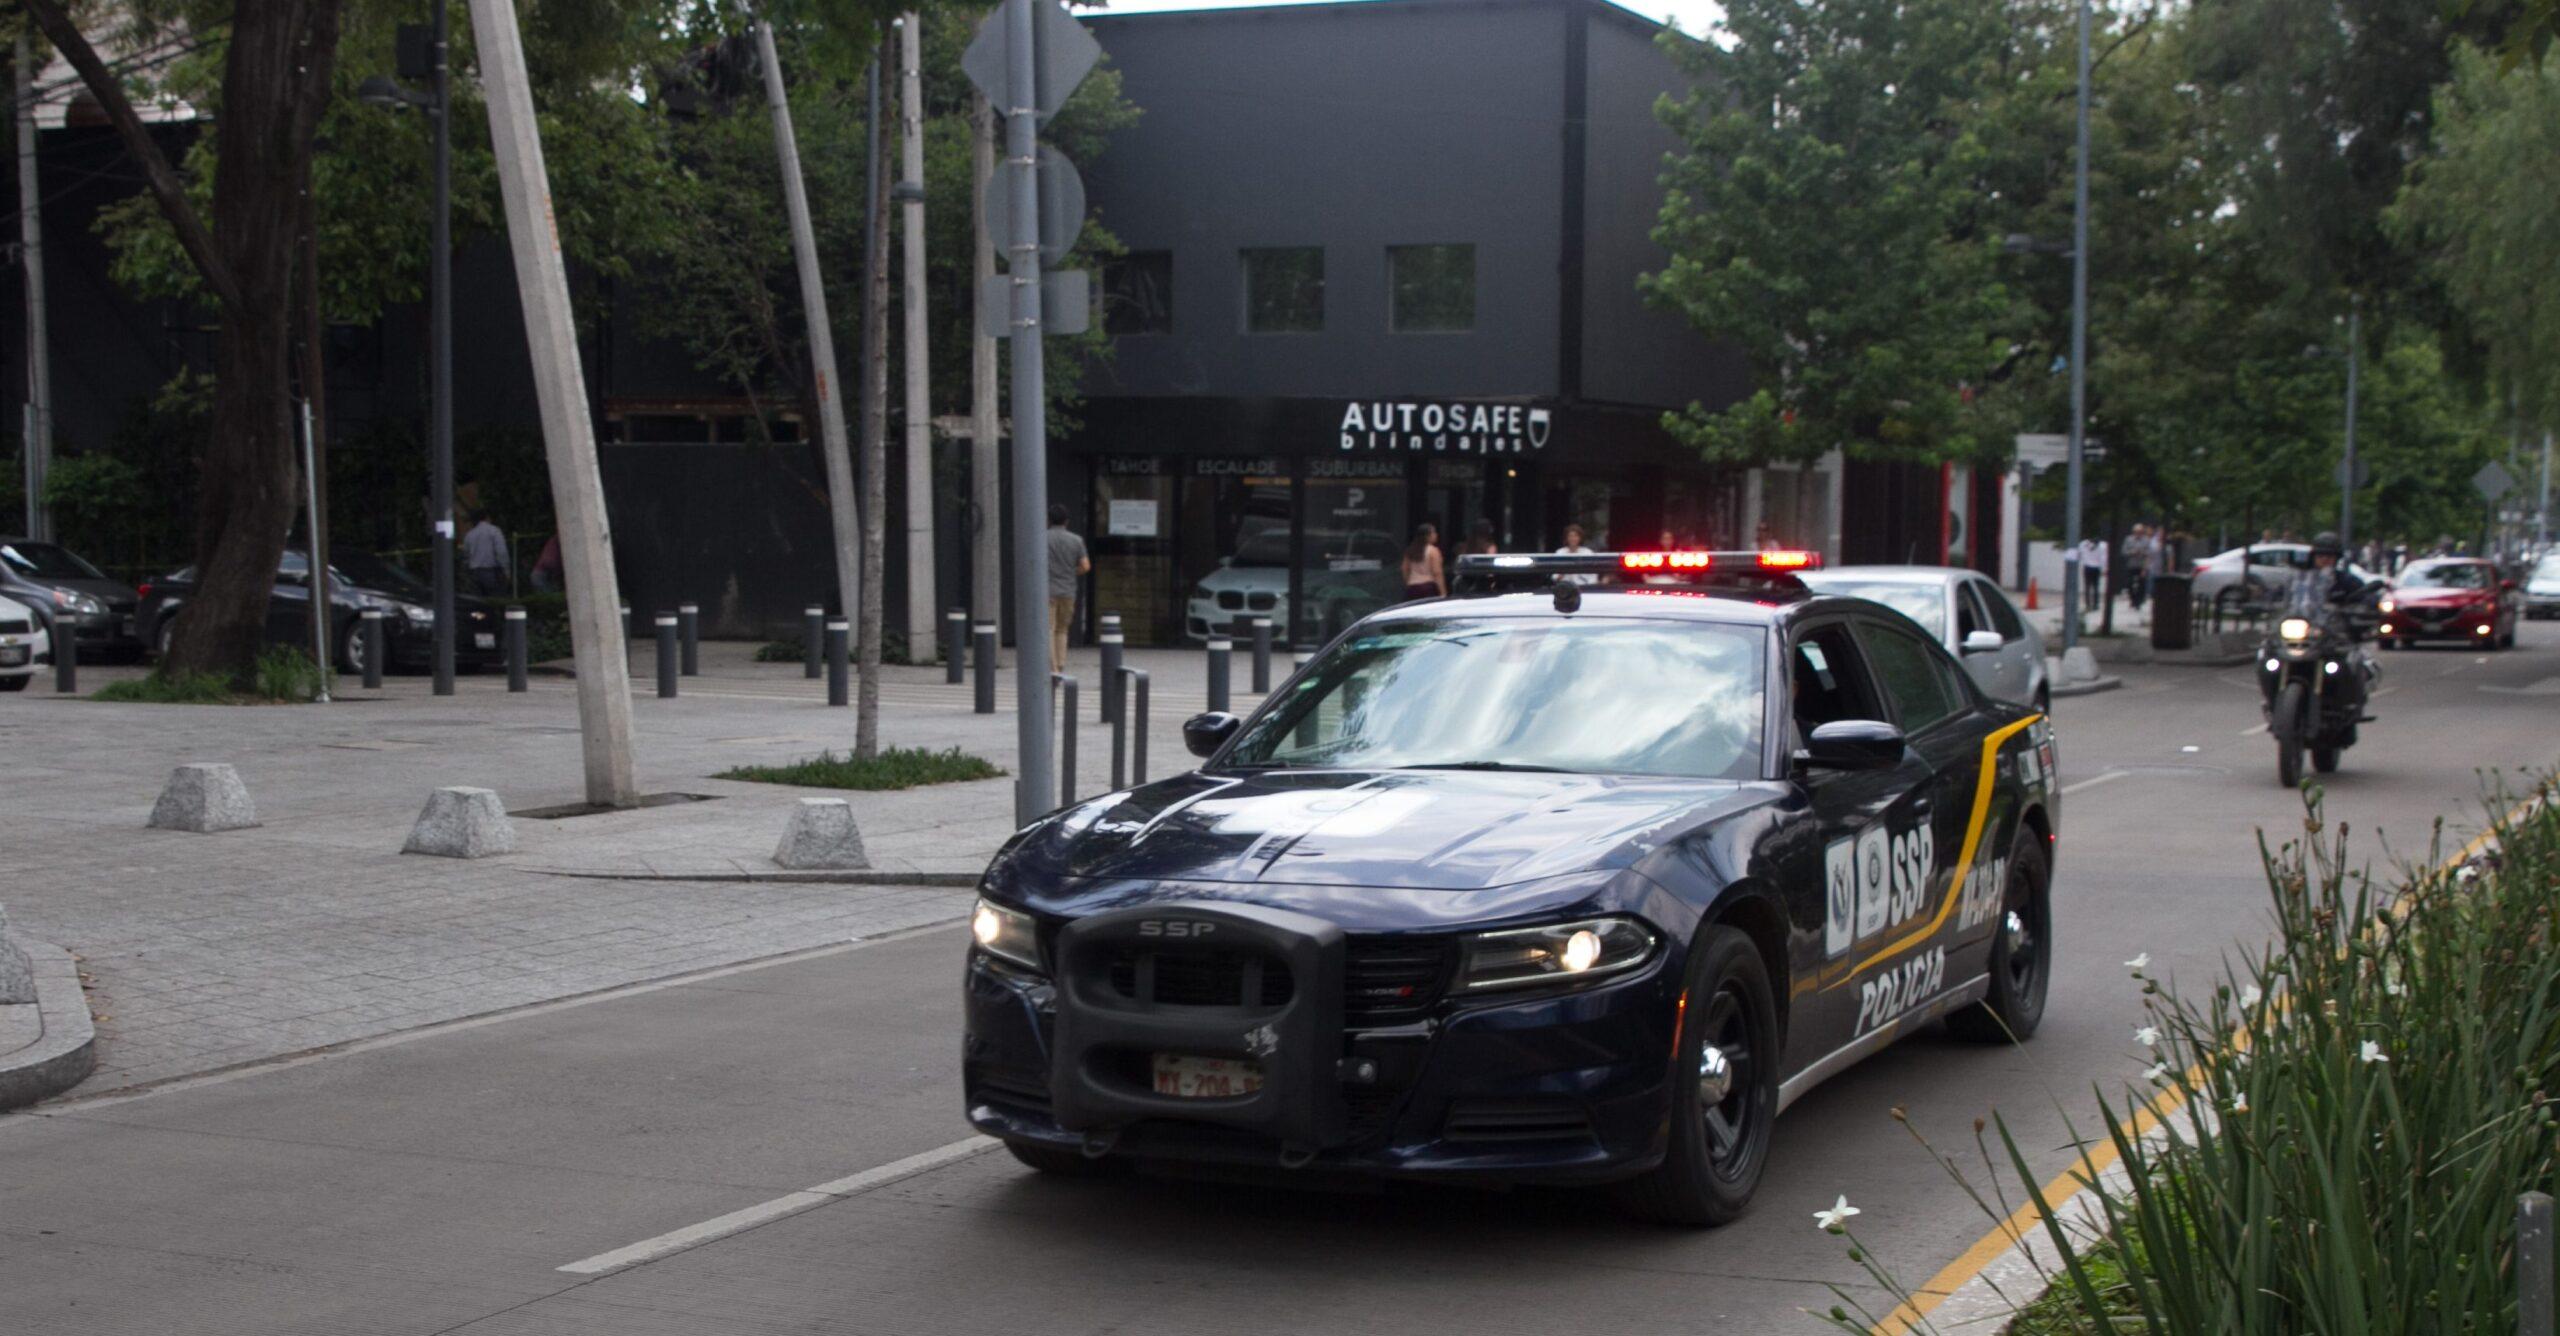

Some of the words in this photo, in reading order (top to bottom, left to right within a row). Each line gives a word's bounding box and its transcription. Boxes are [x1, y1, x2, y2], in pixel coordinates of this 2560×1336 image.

[1340, 402, 1522, 435] AUTOSAFE
[1340, 431, 1522, 455] blindajes
[1109, 459, 1160, 474] TAHOE
[1197, 459, 1277, 475] ESCALADE
[1311, 459, 1404, 476] SUBURBAN
[1890, 823, 1934, 927] SSP
[1138, 919, 1216, 937] SSP
[1853, 944, 1946, 1038] POLICIA
